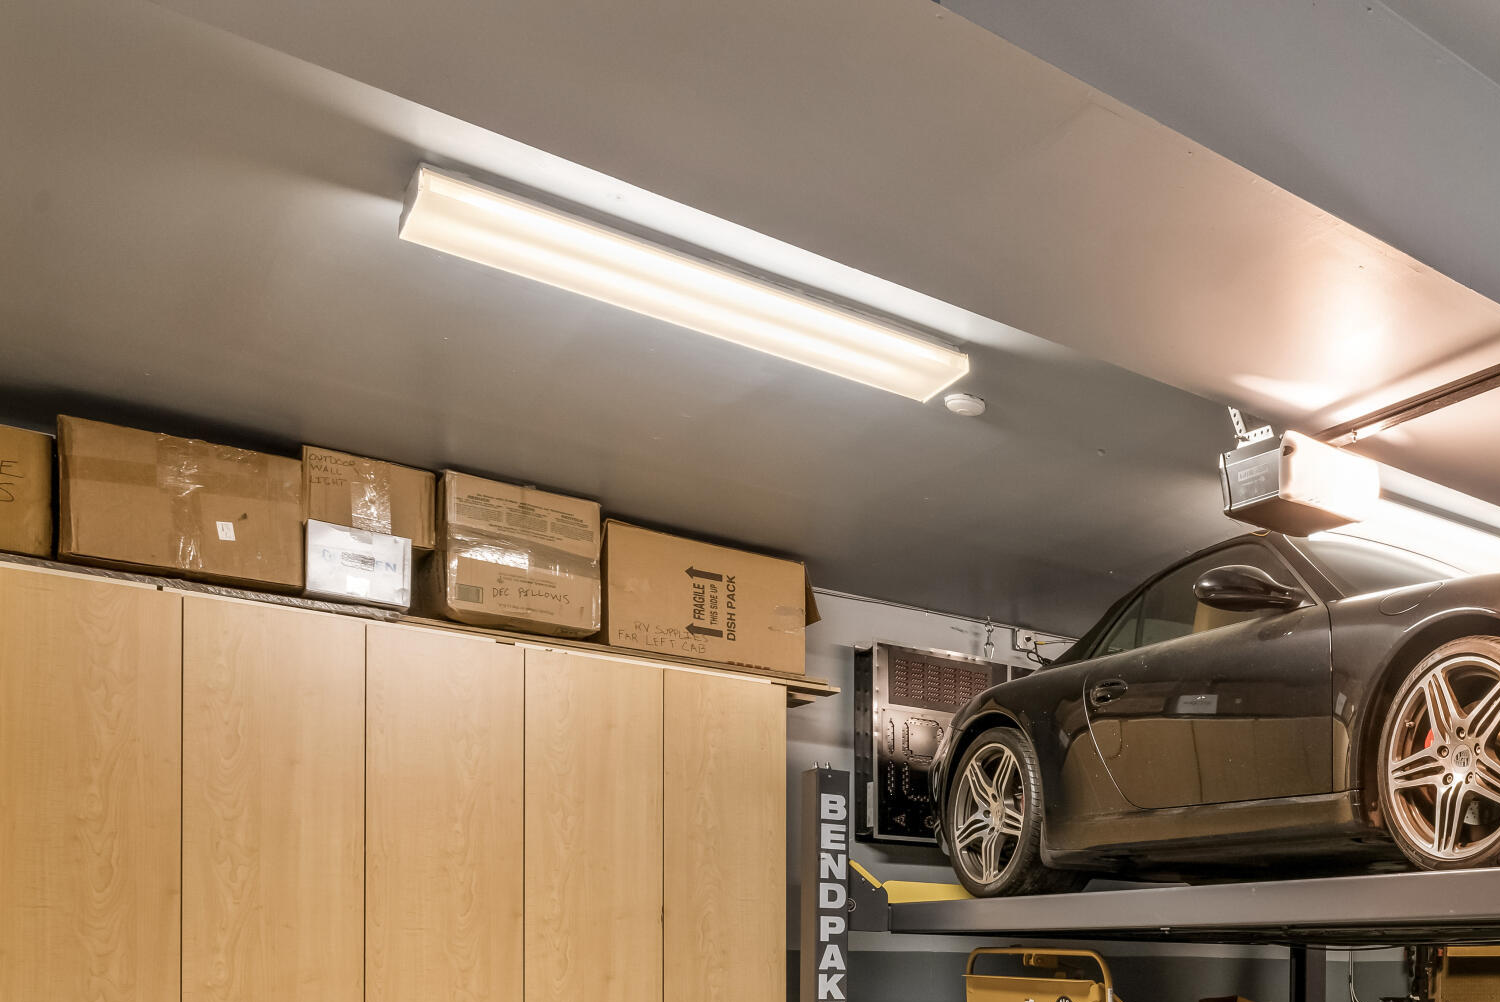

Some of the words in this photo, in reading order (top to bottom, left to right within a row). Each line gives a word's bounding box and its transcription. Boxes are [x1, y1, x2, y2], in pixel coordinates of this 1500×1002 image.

[310, 463, 342, 476] WALL
[310, 477, 347, 487] LIGHT
[492, 587, 509, 598] DEC
[518, 587, 570, 605] PILLOWS
[710, 584, 718, 593] UP
[726, 575, 737, 609] PACK
[692, 583, 705, 621] FRAGILE
[710, 594, 718, 610] SIDE
[710, 612, 718, 625] THIS
[726, 612, 737, 641] DISH
[618, 629, 638, 641] FAR
[645, 637, 675, 647] LEFT
[681, 641, 706, 654] CAB
[818, 793, 847, 1000] BENDPAK
